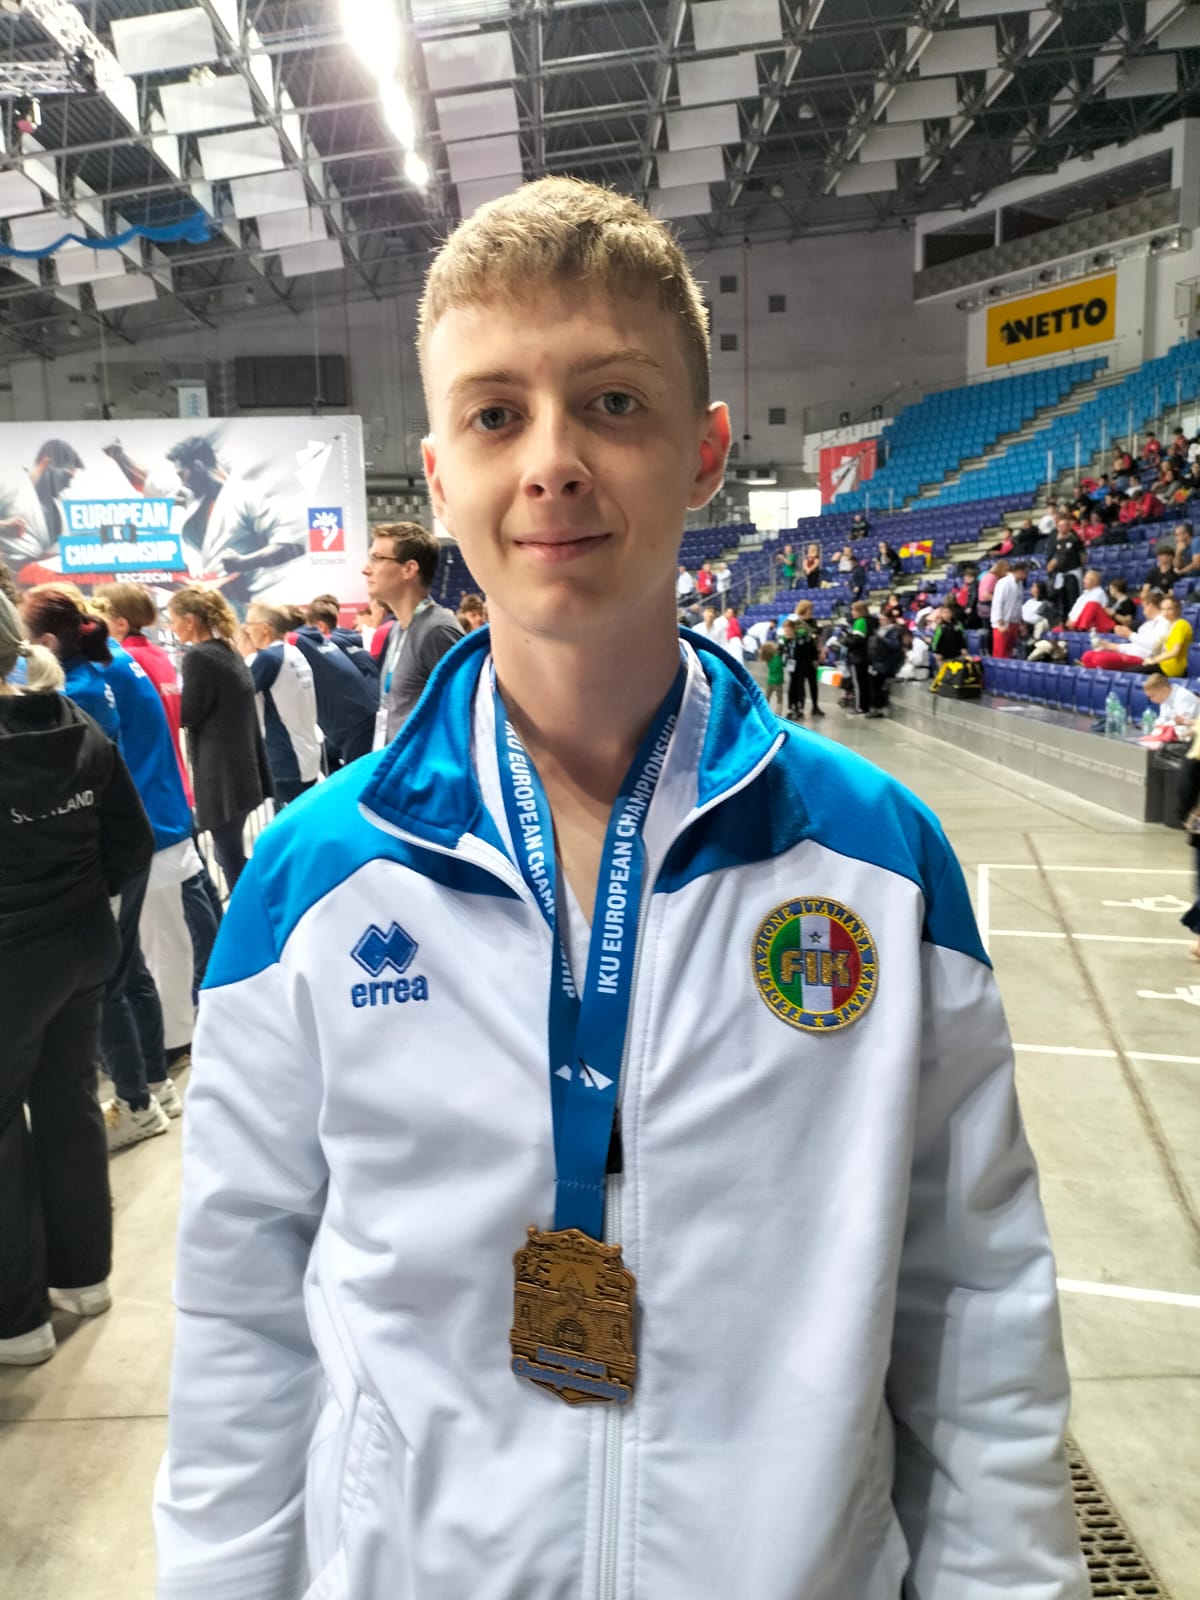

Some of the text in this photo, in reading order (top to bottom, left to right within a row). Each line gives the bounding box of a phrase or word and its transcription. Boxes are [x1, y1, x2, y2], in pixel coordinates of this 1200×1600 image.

[1014, 298, 1107, 340] NETTO
[70, 502, 169, 529] EUROPEAN
[65, 541, 177, 566] CHAMPIONSHIP
[115, 572, 173, 584] SZCZECIN
[508, 751, 544, 851] EUROPEAN
[597, 713, 677, 995] IKU EUROPEAN CHAMPIONSHIP
[756, 900, 876, 1024] FEDERAZIONE ITALIANA KARATE
[780, 949, 850, 987] FIK
[350, 975, 429, 1008] errea
